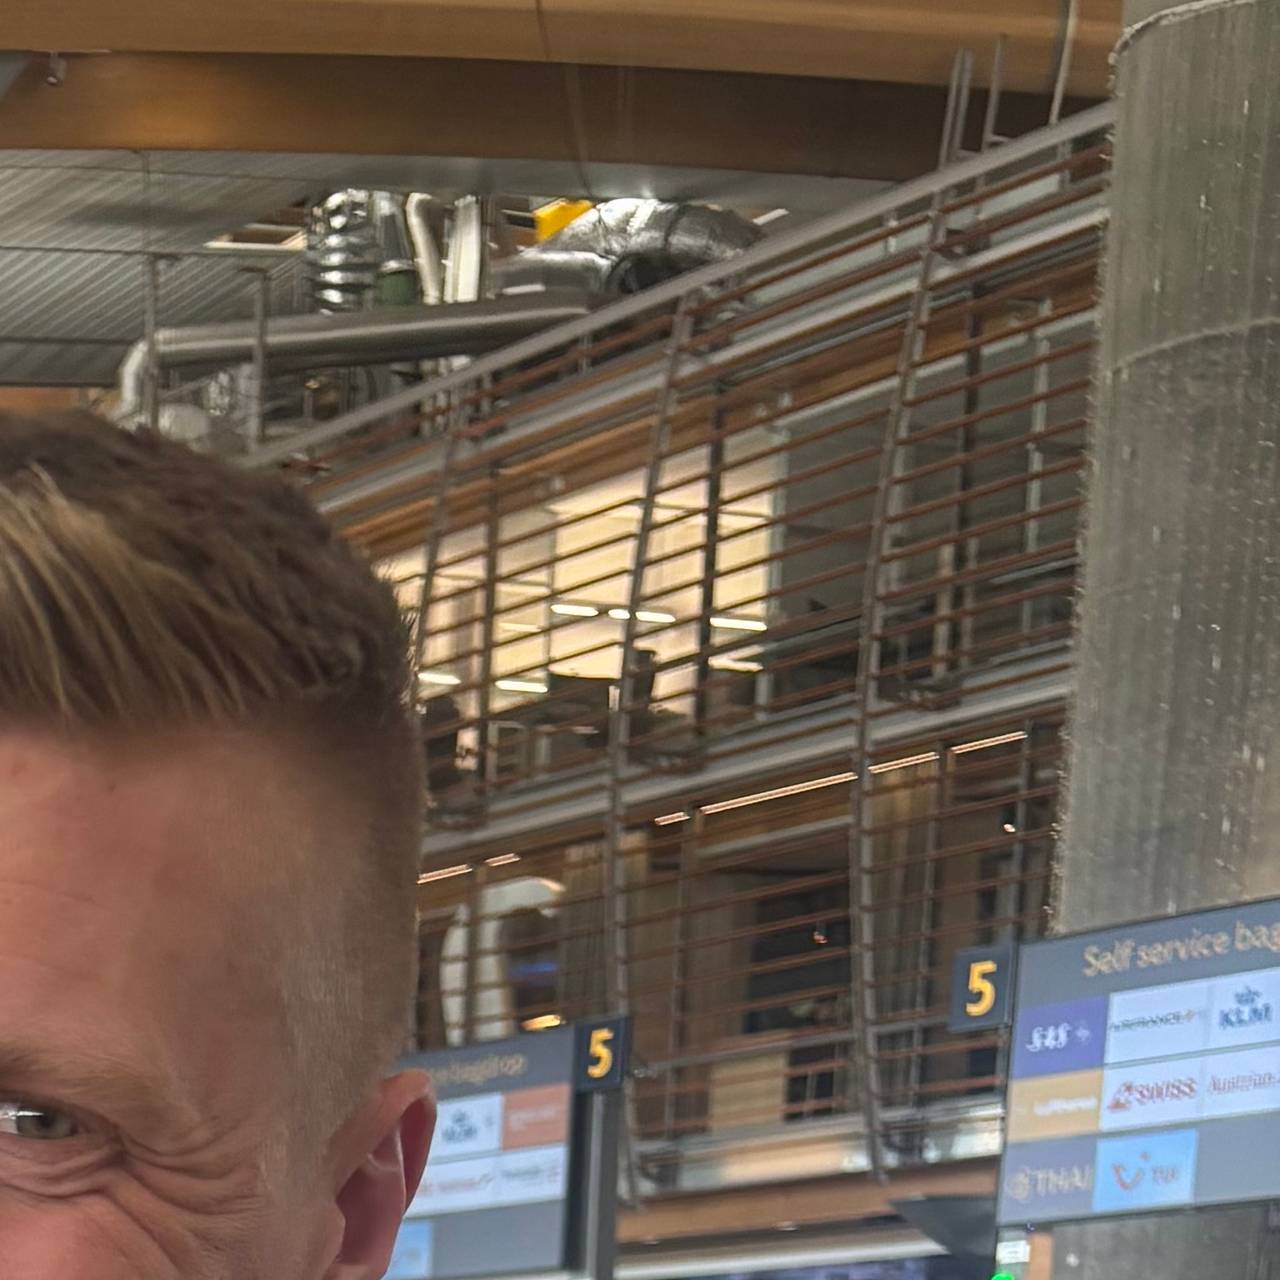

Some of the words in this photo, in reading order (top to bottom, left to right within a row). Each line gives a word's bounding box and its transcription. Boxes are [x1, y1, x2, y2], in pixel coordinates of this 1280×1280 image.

[1083, 938, 1135, 977] Self
[1137, 928, 1230, 968] service
[965, 960, 998, 1017] 5
[1219, 1003, 1272, 1029] KLM
[586, 1028, 615, 1079] 5
